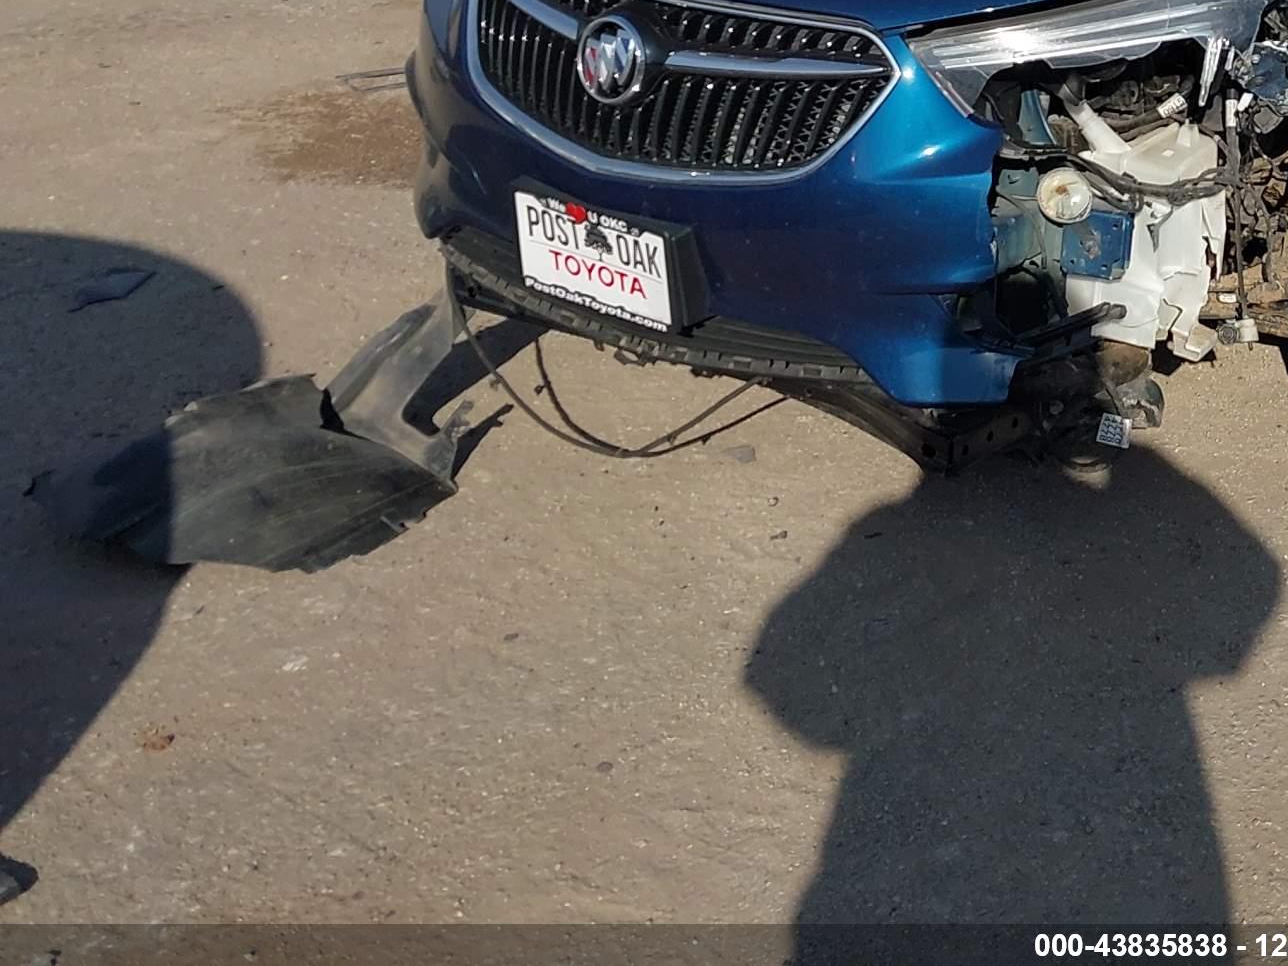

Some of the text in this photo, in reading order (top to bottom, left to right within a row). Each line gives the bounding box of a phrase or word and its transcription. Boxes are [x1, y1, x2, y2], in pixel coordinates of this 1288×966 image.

[526, 205, 662, 279] POST OAK
[587, 211, 598, 223] U
[599, 216, 629, 231] OKC
[549, 249, 648, 299] TOYOTA
[524, 276, 668, 332] PostOakToyota.com
